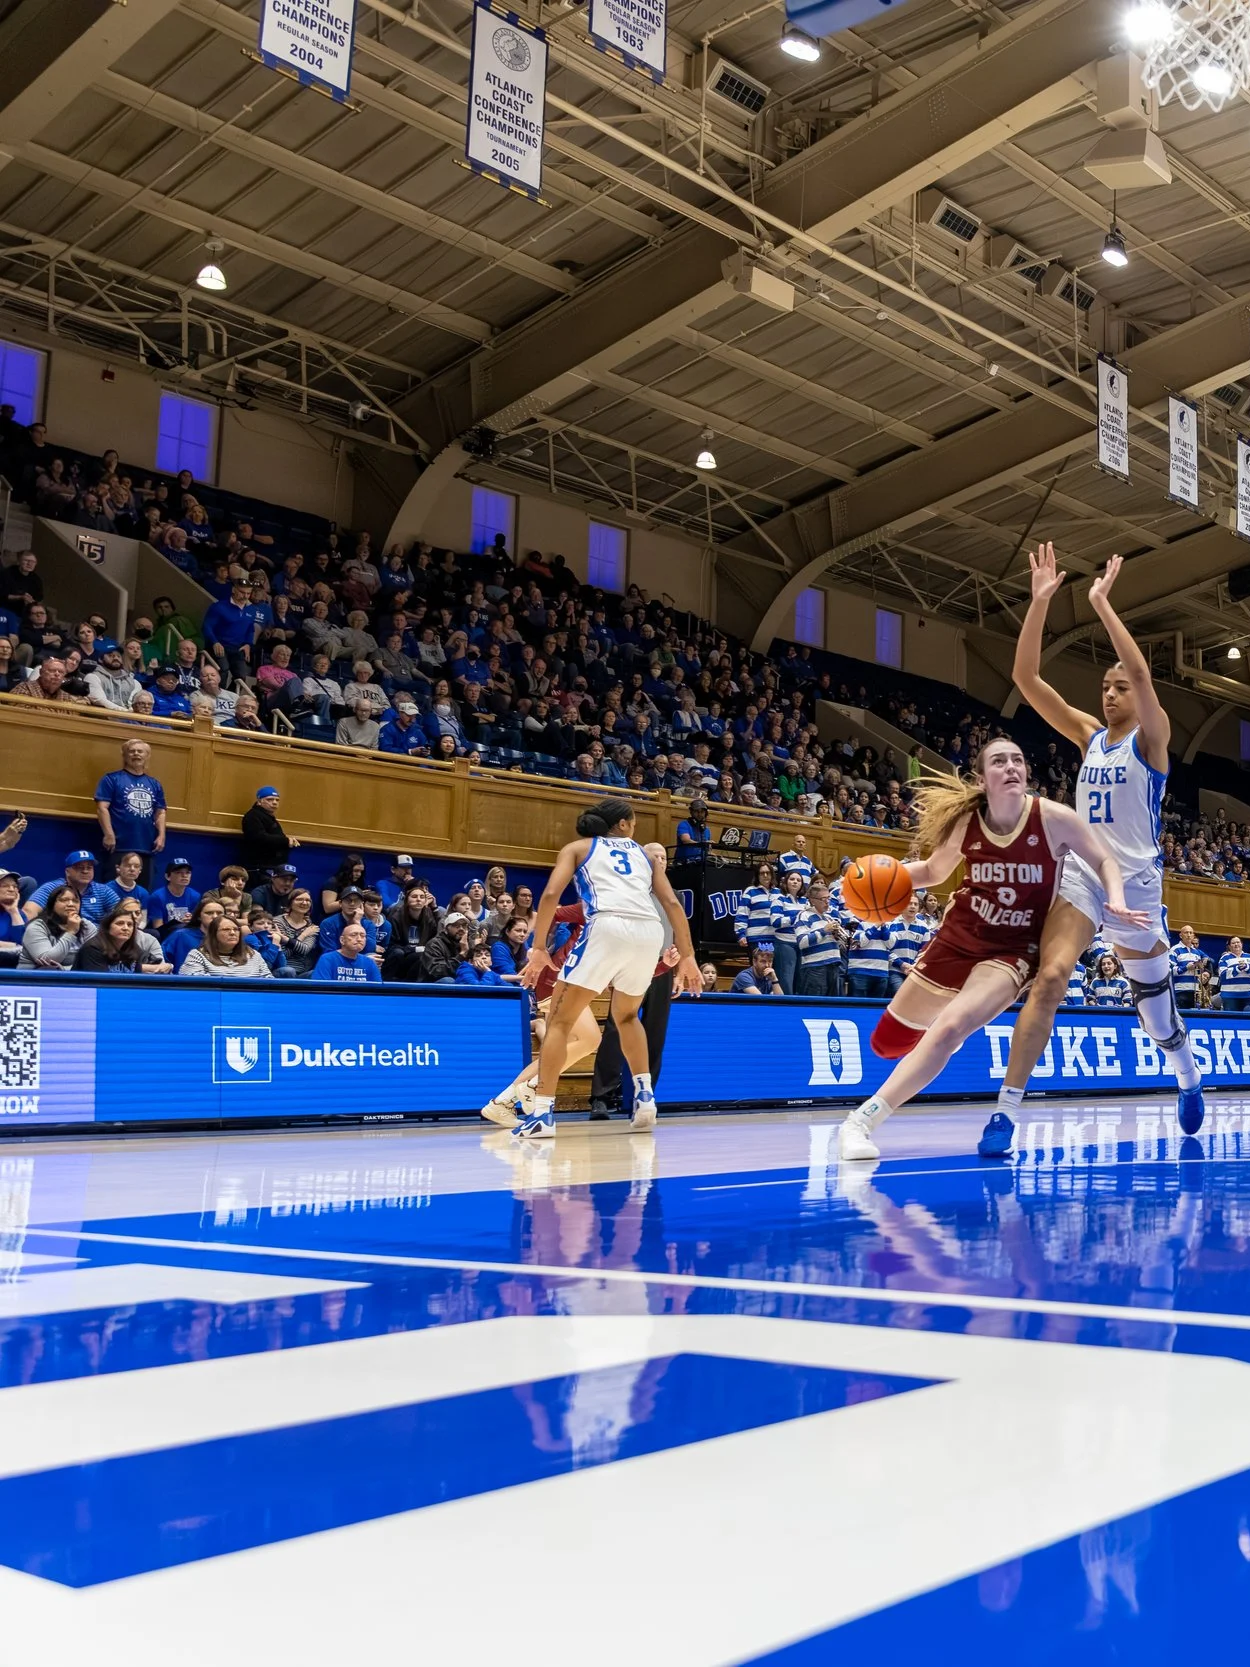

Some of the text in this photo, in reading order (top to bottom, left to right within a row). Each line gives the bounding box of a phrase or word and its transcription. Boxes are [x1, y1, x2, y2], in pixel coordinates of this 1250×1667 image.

[272, 0, 345, 48] CHAMPIONS
[609, 11, 650, 41] TOURNAMENT
[632, 13, 656, 35] SEASON
[277, 20, 339, 59] REGULAR SEASON
[616, 26, 644, 51] 1963
[289, 43, 324, 70] 2004
[485, 72, 534, 104] ATLANTIC
[492, 89, 525, 114] COAST
[474, 94, 542, 137] CONFERENCE
[476, 109, 538, 149] CHAMPIONS
[486, 131, 527, 157] TOURNAMENT
[491, 149, 520, 171] 2005
[213, 700, 236, 710] UKE
[1080, 766, 1127, 785] DUKE
[1088, 790, 1115, 824] 21
[610, 850, 632, 875] 3
[970, 862, 1044, 884] BOSTON
[970, 895, 1035, 927] COLLEGE
[280, 1043, 440, 1067] DukeHealth
[984, 1025, 1122, 1079] DUKE
